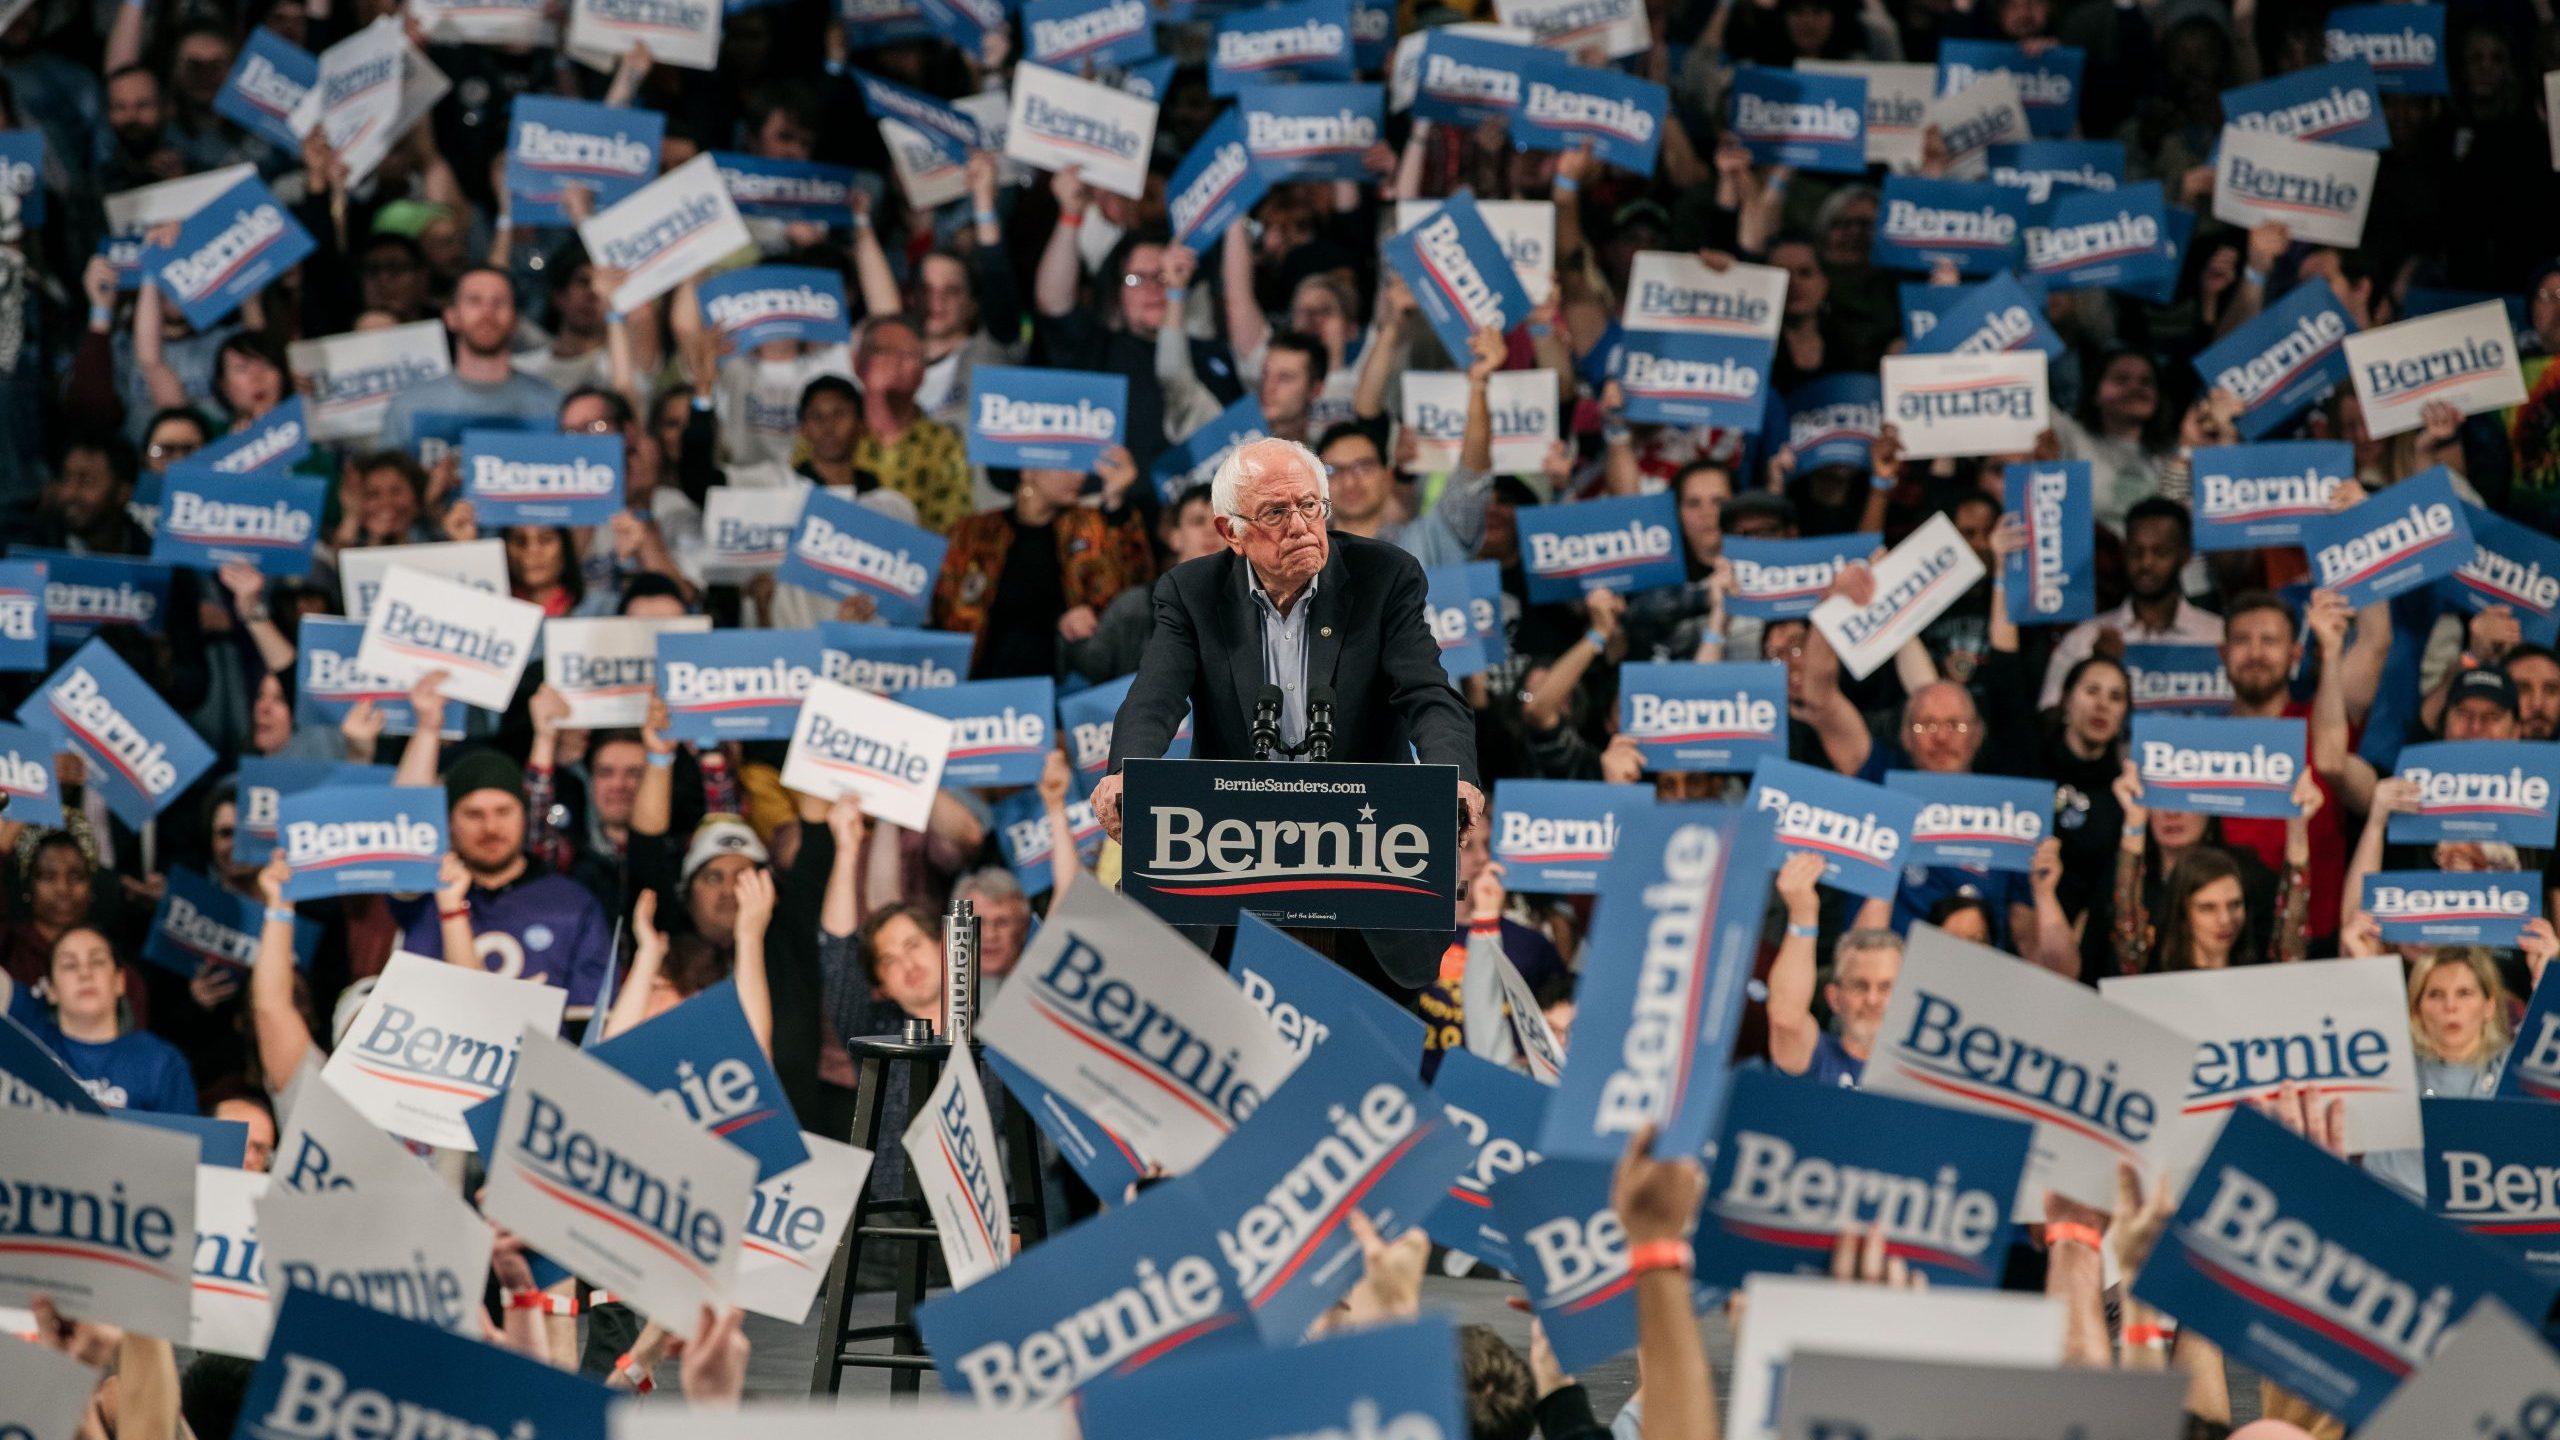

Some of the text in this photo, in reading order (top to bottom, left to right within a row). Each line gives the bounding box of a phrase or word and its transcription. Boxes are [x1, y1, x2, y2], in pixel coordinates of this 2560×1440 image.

[1032, 2, 1146, 54] Bernie
[1217, 20, 1345, 70] Bernie
[2324, 25, 2439, 66] Bernie
[1424, 52, 1521, 102] Bern
[1022, 93, 1141, 160] Bernie
[1247, 110, 1377, 152] Bernie
[1525, 80, 1656, 143] Bernie
[1735, 94, 1861, 140] Bernie
[518, 120, 650, 176] Bernie
[1170, 140, 1248, 226] Bernie
[2227, 155, 2359, 213] Bernie
[603, 192, 724, 263] Bernie
[1884, 198, 2018, 243] Bernie
[2022, 208, 2159, 264] Bernie
[161, 202, 285, 299] Bernie
[1418, 211, 1507, 333] Bernie
[708, 284, 839, 332] Bernie
[1640, 279, 1770, 327] Bernie
[1622, 348, 1762, 401] Bernie
[2214, 308, 2347, 402] Bernie
[2364, 333, 2508, 396] Bernie
[979, 391, 1118, 442] Bernie
[1416, 402, 1547, 438] Benie
[1898, 382, 2036, 424] Bernie
[471, 454, 616, 500] Bernie
[166, 490, 313, 546] Bernie
[1529, 519, 1672, 573] Bernie
[2031, 470, 2069, 614] Bernie
[2316, 501, 2457, 590] Bernie
[801, 513, 930, 598] Bernie
[44, 579, 157, 622] ernie
[1838, 545, 1959, 647] Bernie
[381, 598, 518, 670] Bernie
[561, 650, 656, 694] Bern
[666, 658, 815, 704] Bernie
[51, 665, 179, 798] Bernie
[949, 705, 1046, 749] rnie
[1629, 690, 1779, 734] Bernie
[803, 711, 931, 785] Bernie
[2141, 738, 2296, 785] Bernie
[1213, 777, 1367, 794] BernieSanders.com
[285, 813, 440, 857] Bernie
[1145, 802, 1431, 878] Bernie
[1499, 810, 1621, 853] Berni
[1912, 800, 2044, 842] ernie
[163, 893, 262, 964] Bern
[2373, 885, 2532, 916] Bernie
[1594, 822, 1722, 1138] Bernie
[356, 1002, 524, 1093] Berni
[1898, 988, 2157, 1145] Bernie
[2190, 1016, 2390, 1092] ernie
[516, 1088, 727, 1268] Bernie
[1713, 1130, 1999, 1260] Bernie
[2178, 1160, 2456, 1370] Berni
[954, 1253, 1226, 1413] Bernie
